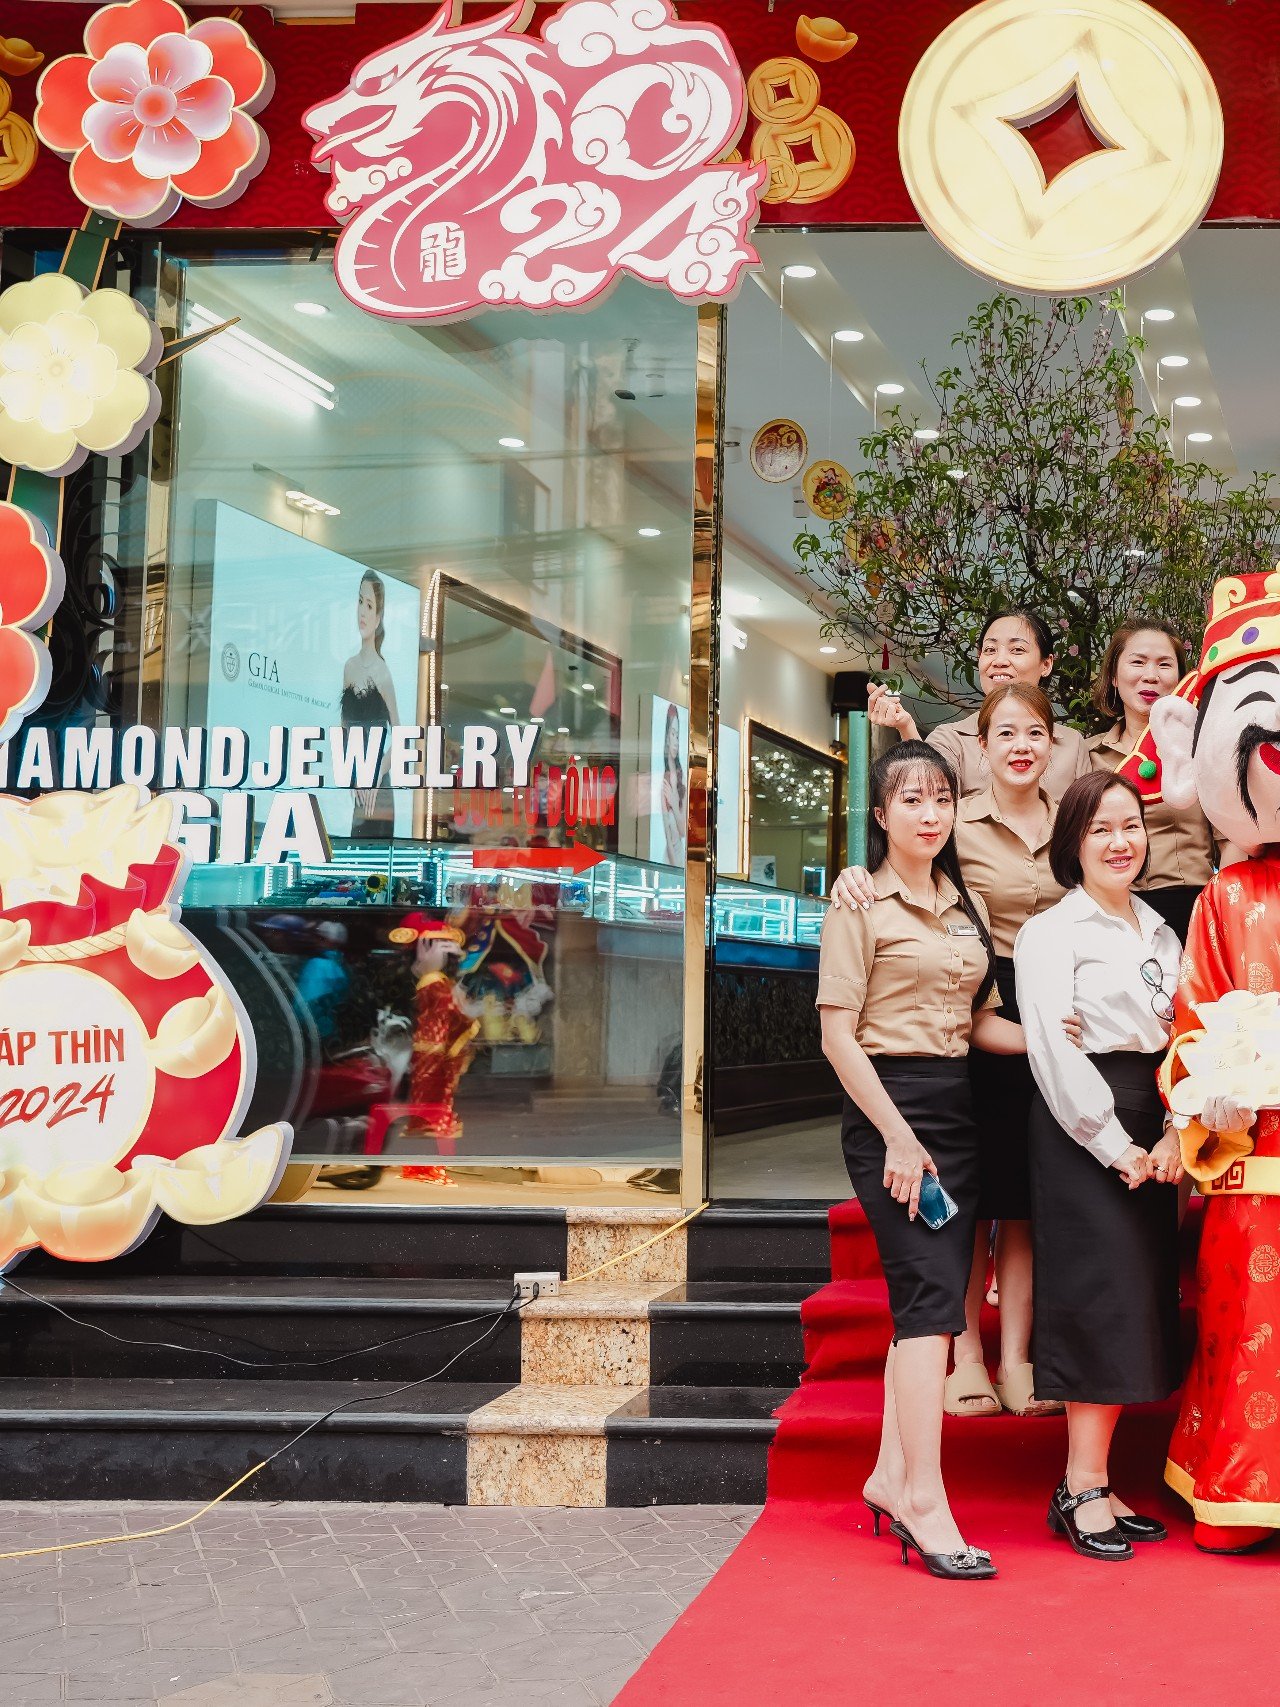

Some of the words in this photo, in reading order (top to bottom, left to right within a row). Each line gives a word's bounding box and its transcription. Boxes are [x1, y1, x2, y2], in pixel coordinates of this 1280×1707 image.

[420, 222, 467, 282] 龍
[248, 652, 280, 683] GIA
[157, 791, 329, 864] GIA
[48, 1024, 125, 1065] THÌN
[0, 1073, 116, 1129] 2024
